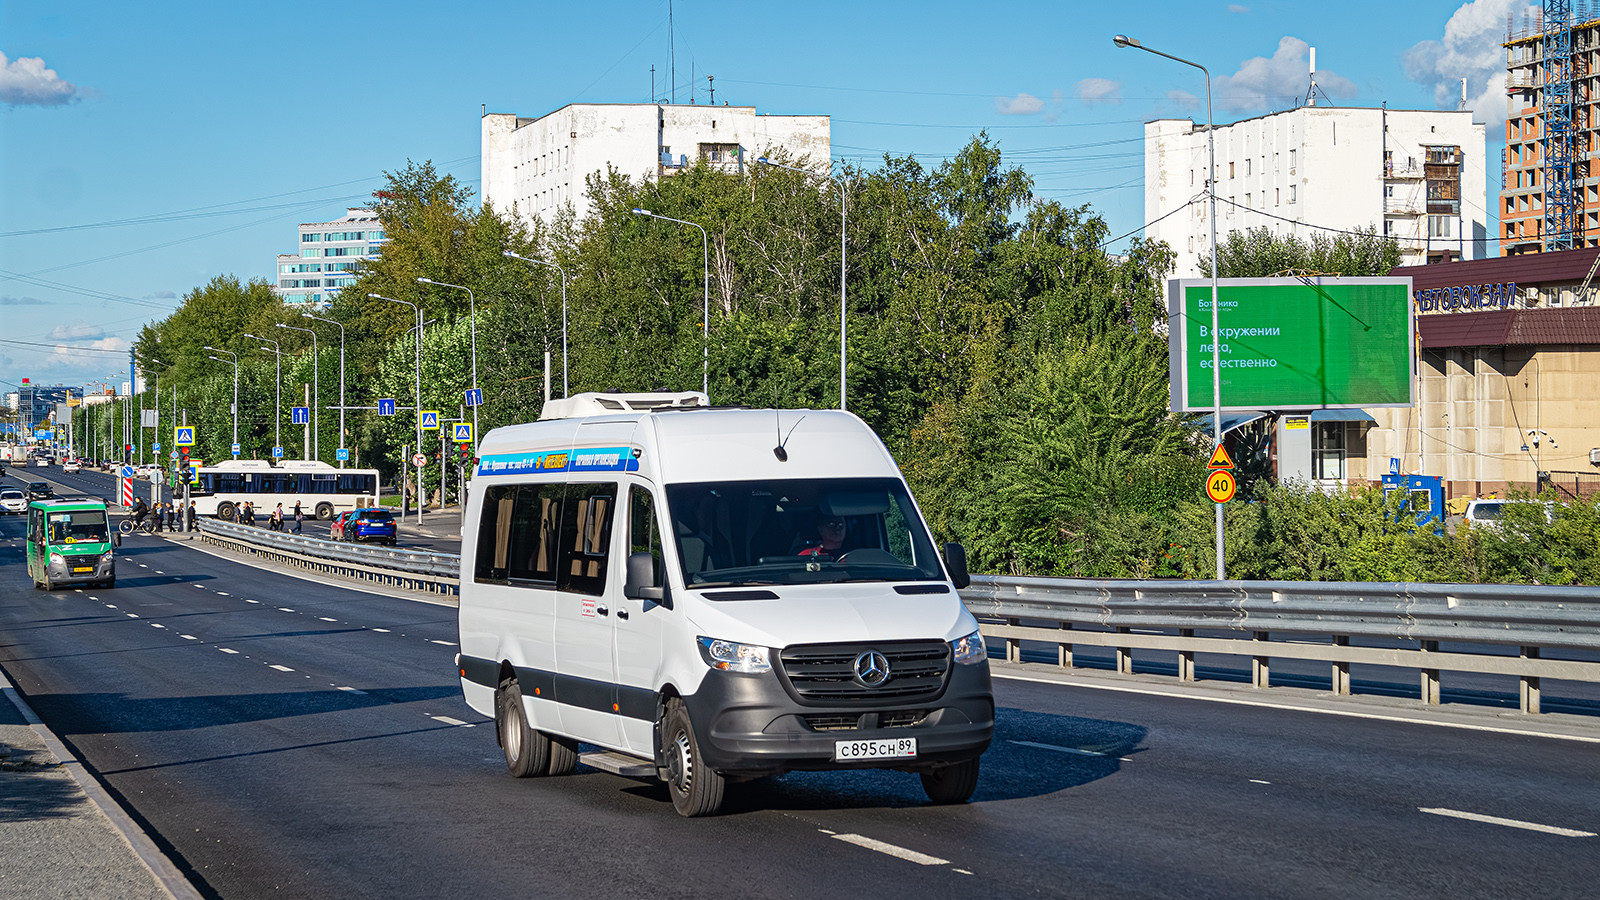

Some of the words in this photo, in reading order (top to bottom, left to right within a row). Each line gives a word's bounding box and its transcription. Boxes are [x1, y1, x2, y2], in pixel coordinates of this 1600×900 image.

[1415, 281, 1517, 313] АВТОВОКЗАЛ
[1198, 298, 1239, 308] Ботника
[1199, 325, 1208, 337] В
[1199, 343, 1232, 354] леа,
[1199, 358, 1278, 368] есественно
[1212, 479, 1229, 492] 40
[899, 740, 911, 750] 89
